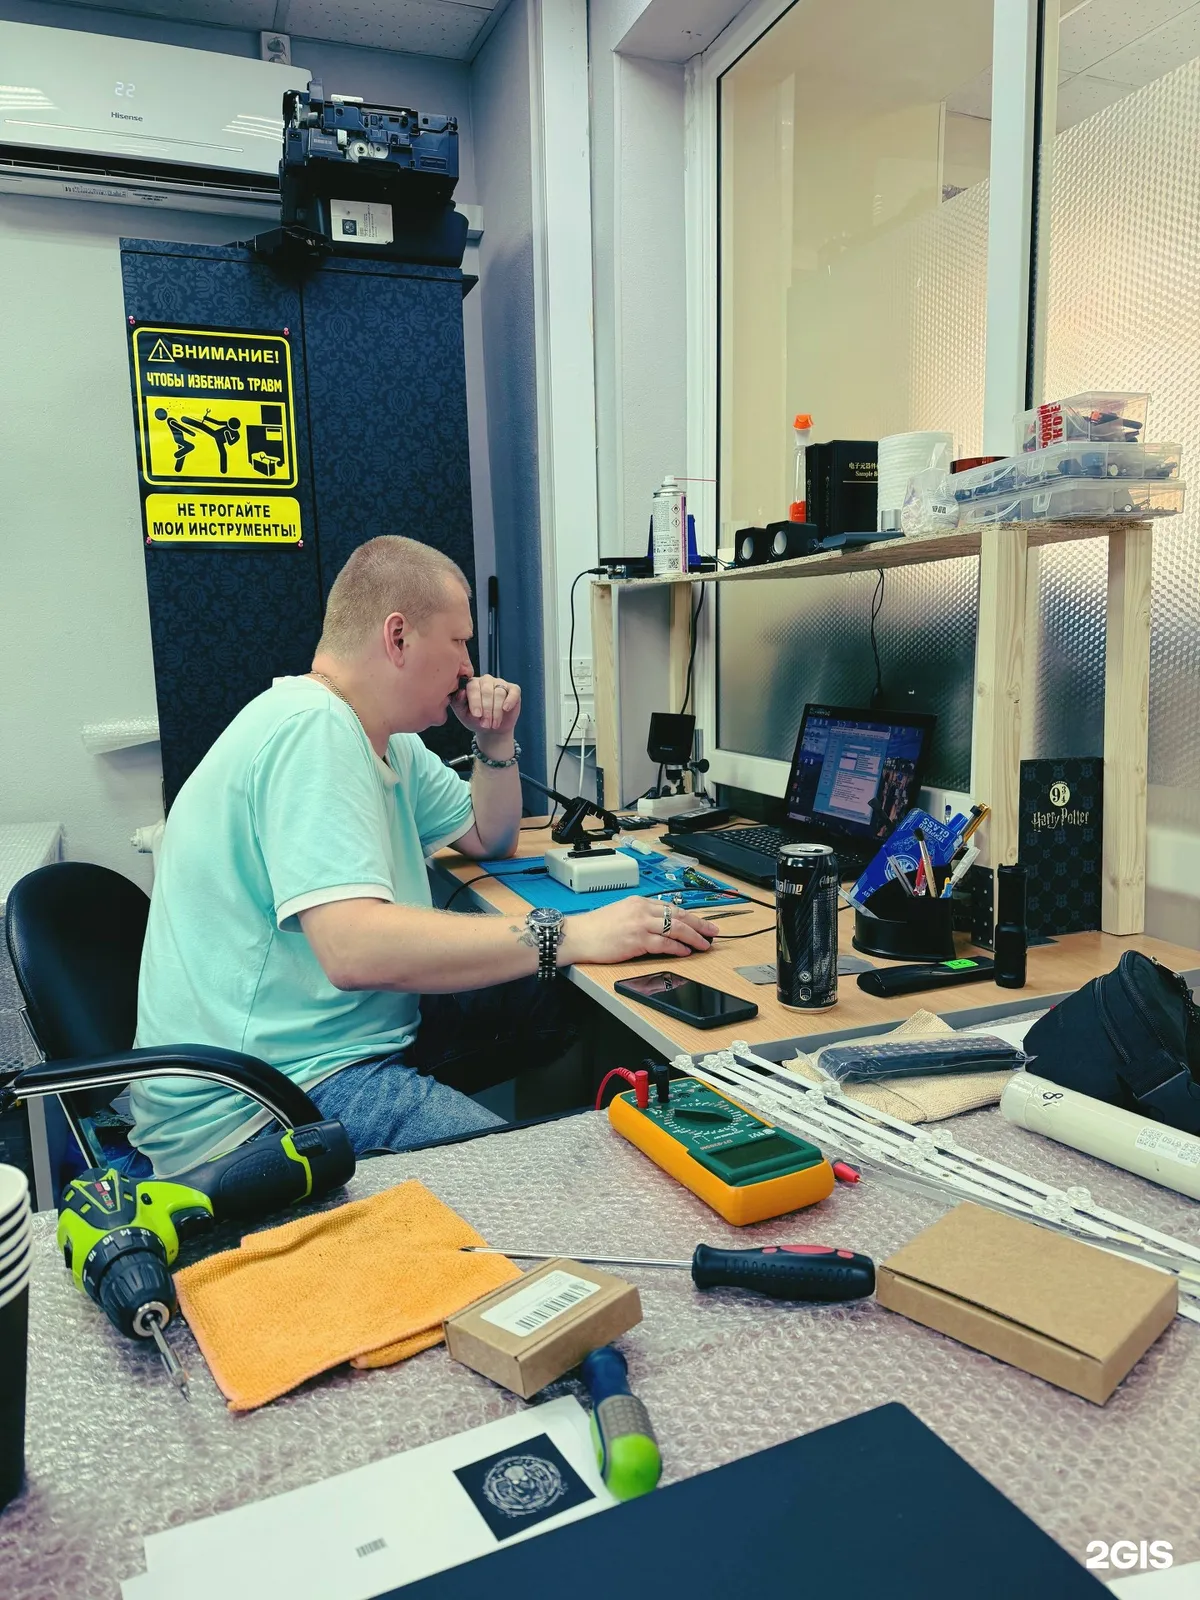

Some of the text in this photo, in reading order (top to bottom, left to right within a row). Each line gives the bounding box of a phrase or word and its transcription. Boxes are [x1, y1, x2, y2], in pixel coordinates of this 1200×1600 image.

[115, 82, 135, 98] 22
[111, 111, 143, 122] Hisense
[172, 344, 280, 364] ВНИМАНИЕ!
[147, 372, 283, 393] ЧТОБЫ ИЗБЕЖАТЬ ТРАВМ
[848, 462, 878, 470] 电子元器件
[177, 501, 271, 518] НЕ ТРОГАЙТЕ
[153, 522, 297, 538] МОИ ИНСТРУМЕНТЫ!
[921, 817, 950, 838] GLASS
[1031, 807, 1090, 833] Harry Potter
[918, 823, 944, 843] TEMPERED
[120, 1228, 132, 1237] 14
